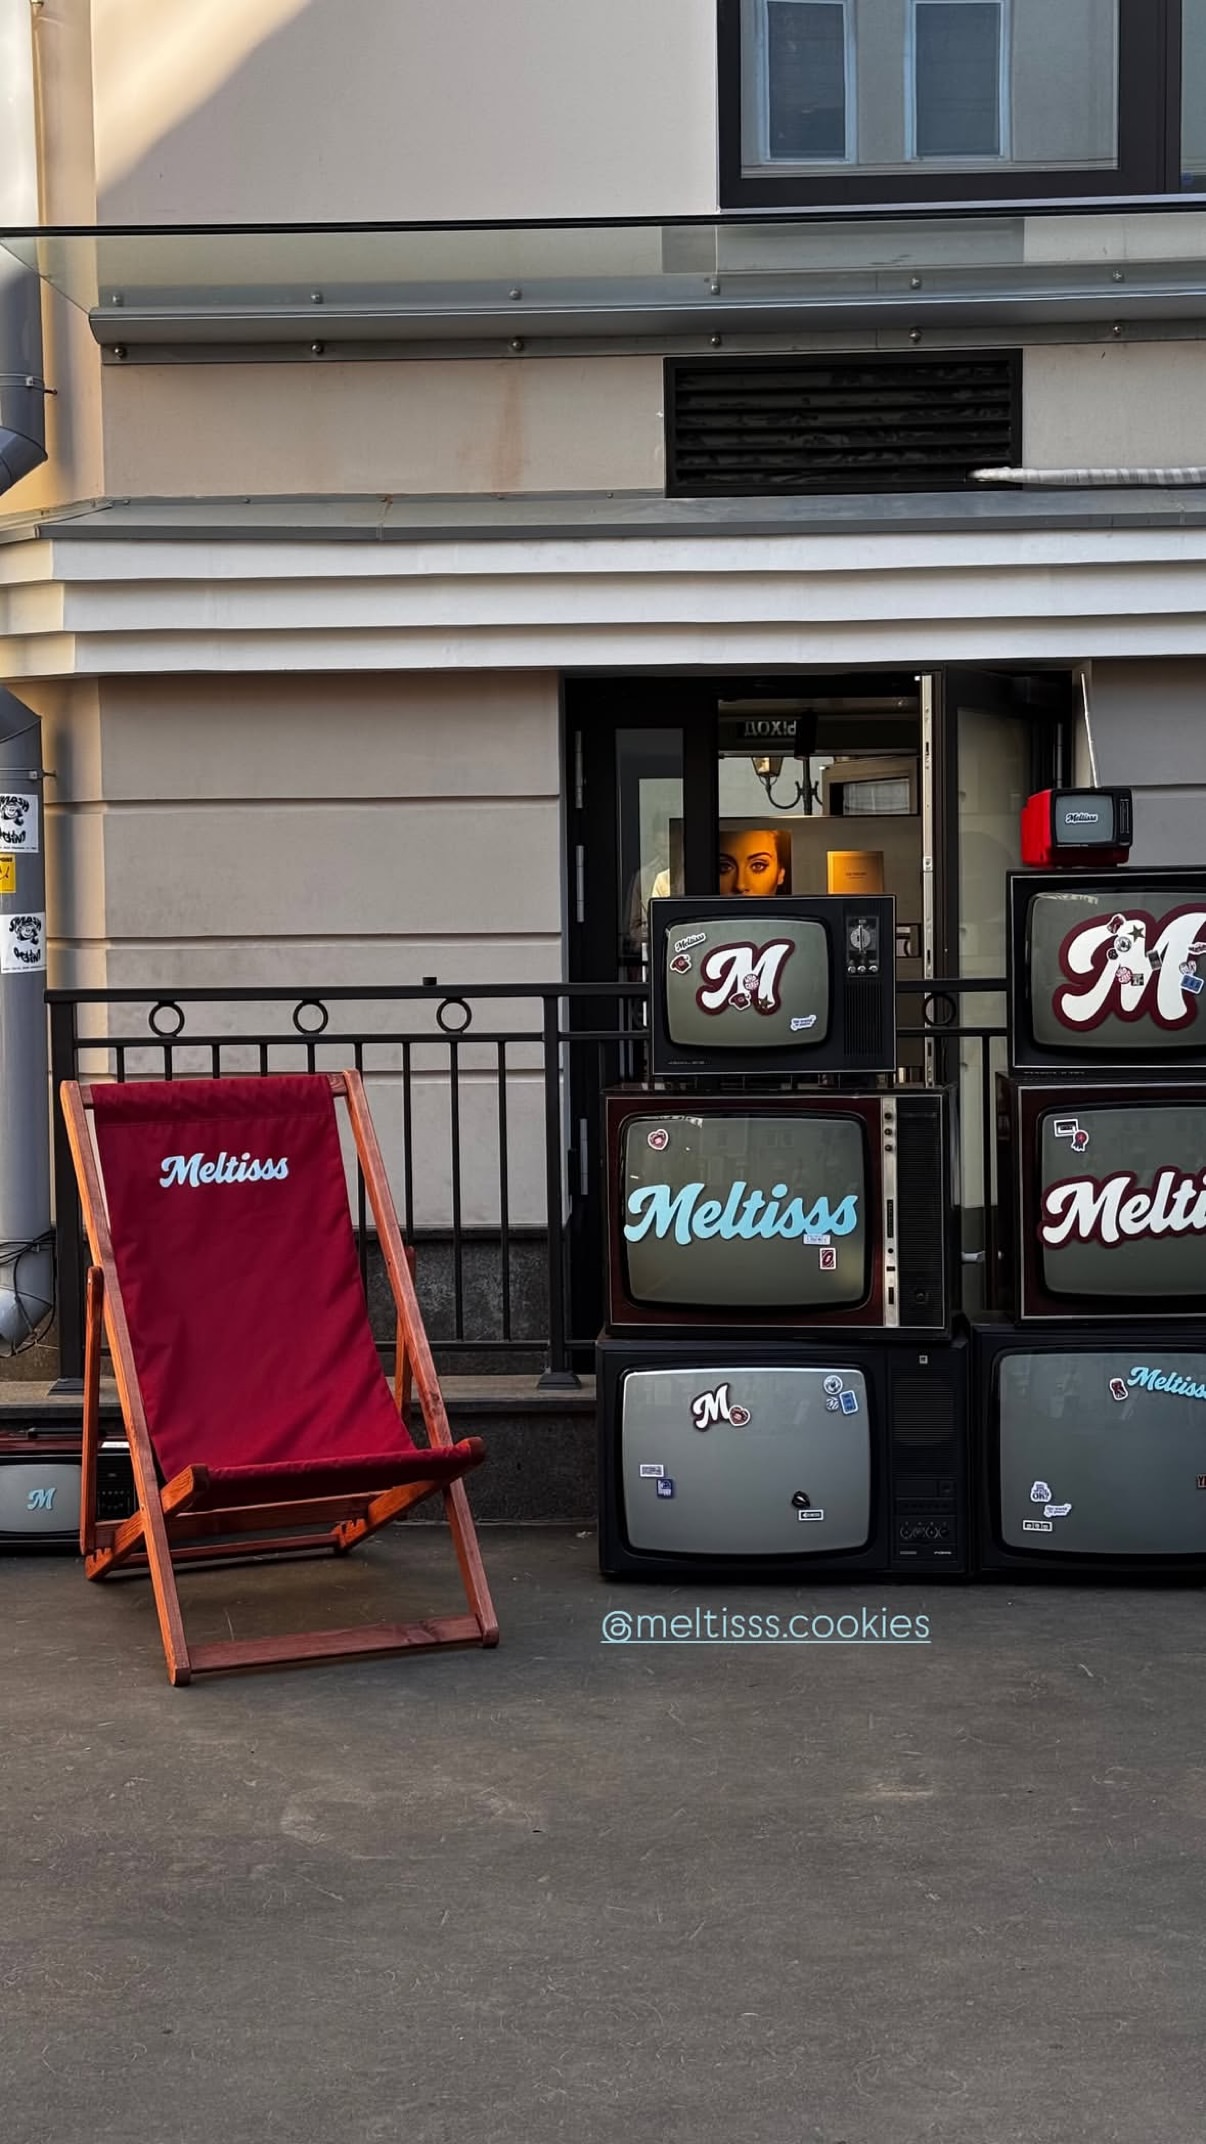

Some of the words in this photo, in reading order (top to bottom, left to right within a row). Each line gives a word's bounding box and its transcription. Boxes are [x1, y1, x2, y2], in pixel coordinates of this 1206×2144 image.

[701, 944, 790, 1010] M
[1061, 912, 1206, 1022] M
[159, 1151, 289, 1188] Meltisss
[624, 1181, 858, 1245] Meltisss
[692, 1384, 729, 1429] M
[27, 1488, 55, 1509] M
